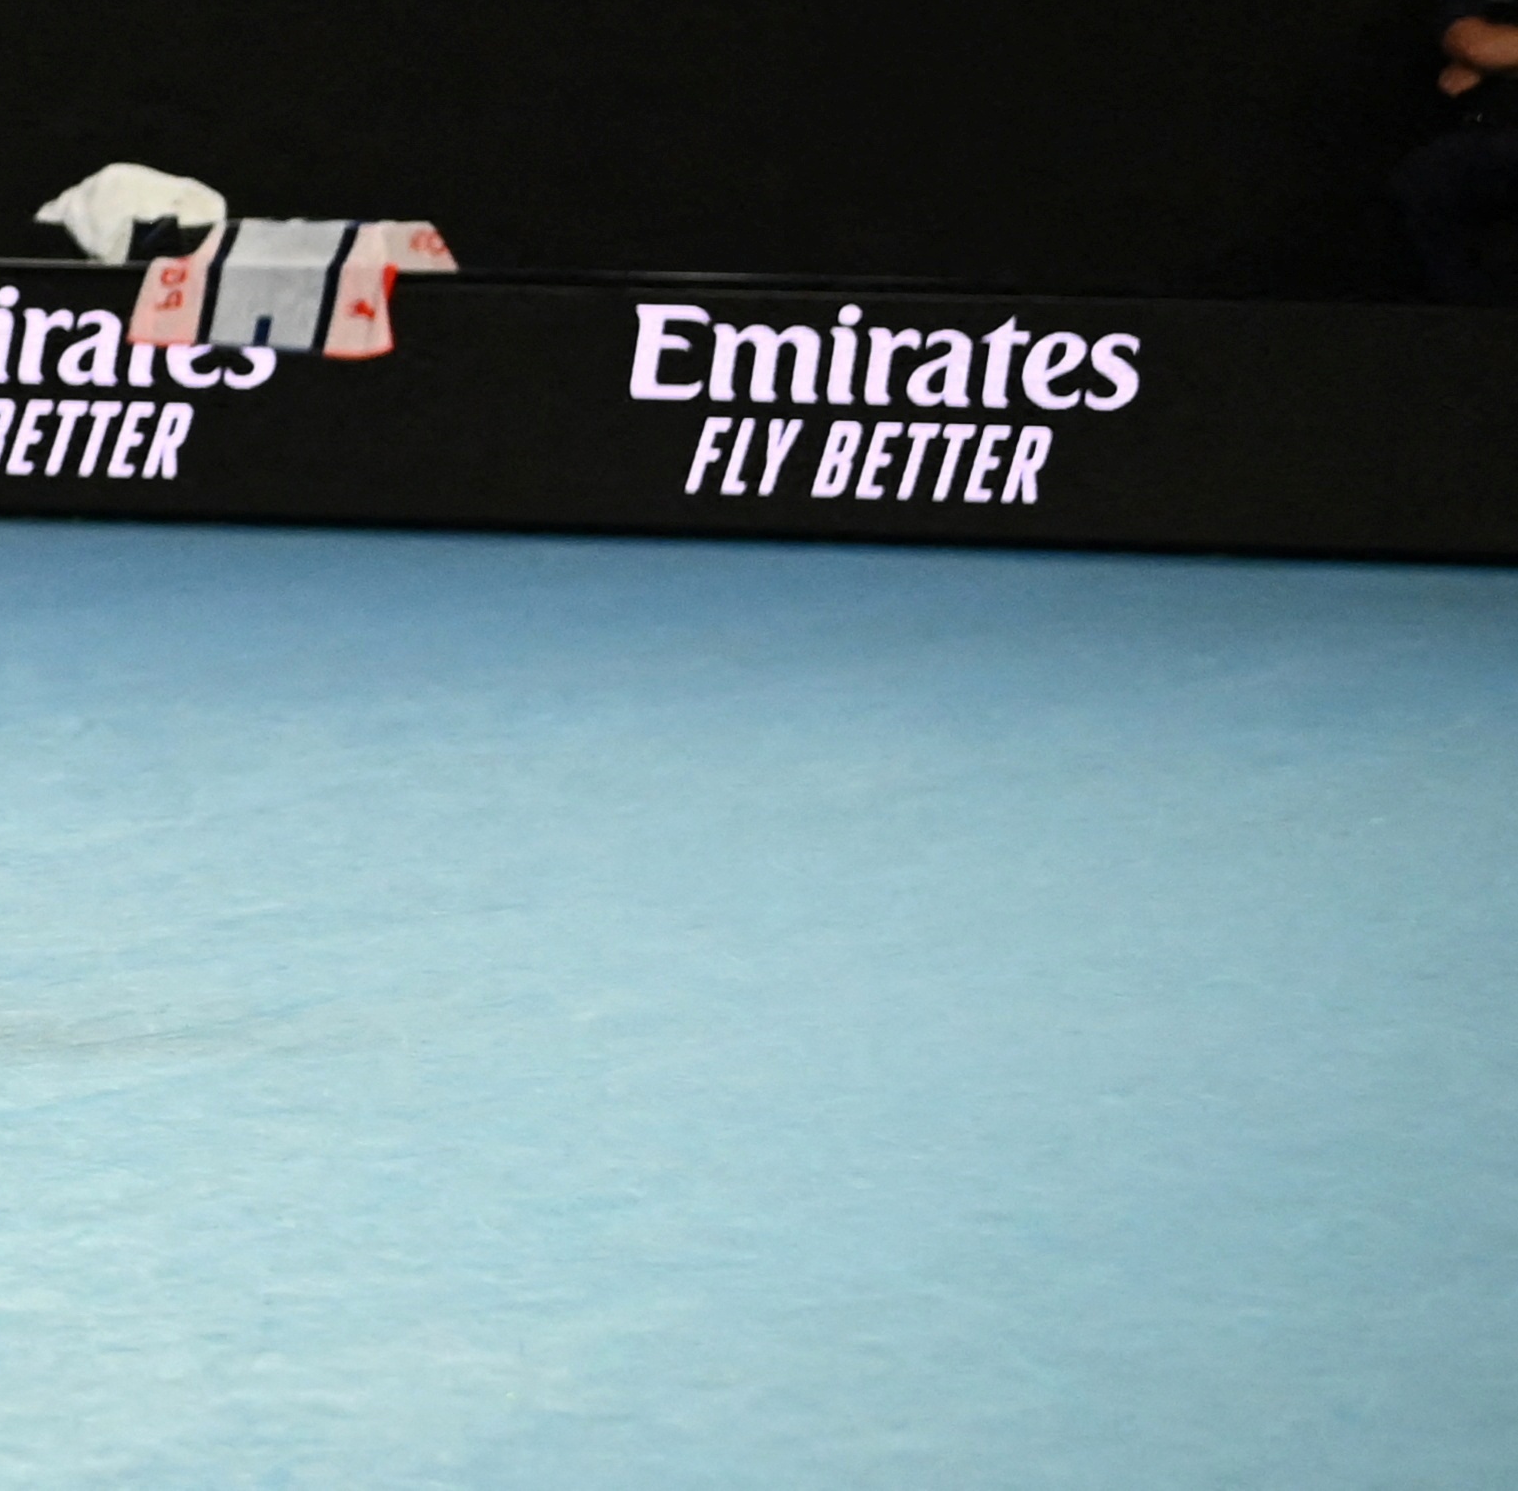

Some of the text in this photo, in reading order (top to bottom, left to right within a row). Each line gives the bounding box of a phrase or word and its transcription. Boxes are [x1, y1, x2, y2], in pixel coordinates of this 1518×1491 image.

[630, 304, 1139, 410] Emirates
[685, 417, 1052, 503] FLY BETTER
